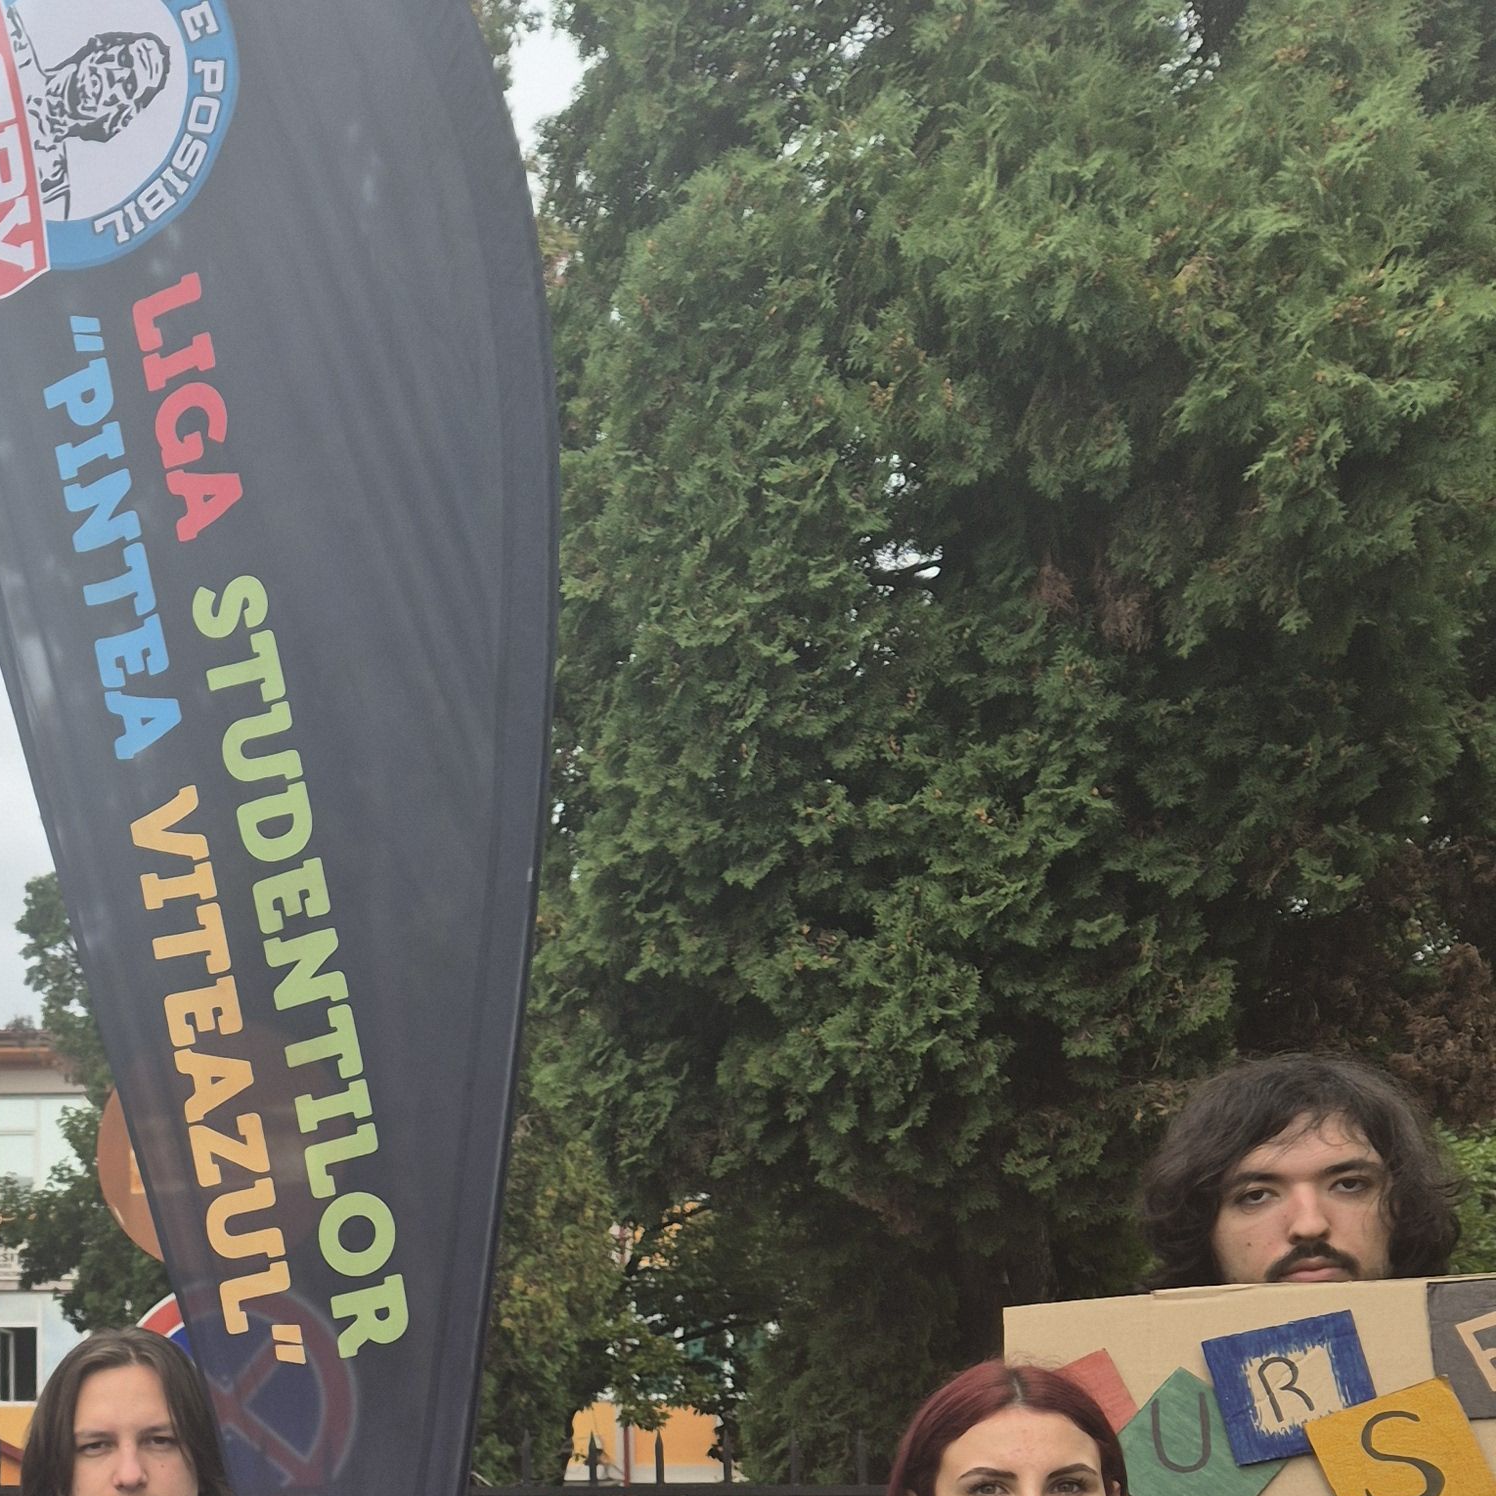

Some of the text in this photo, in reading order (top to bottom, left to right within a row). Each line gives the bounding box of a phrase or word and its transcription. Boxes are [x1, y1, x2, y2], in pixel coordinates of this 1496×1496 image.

[93, 57, 226, 244] POSIBIL
[132, 272, 410, 1359] LIGA STUDENTILOR
